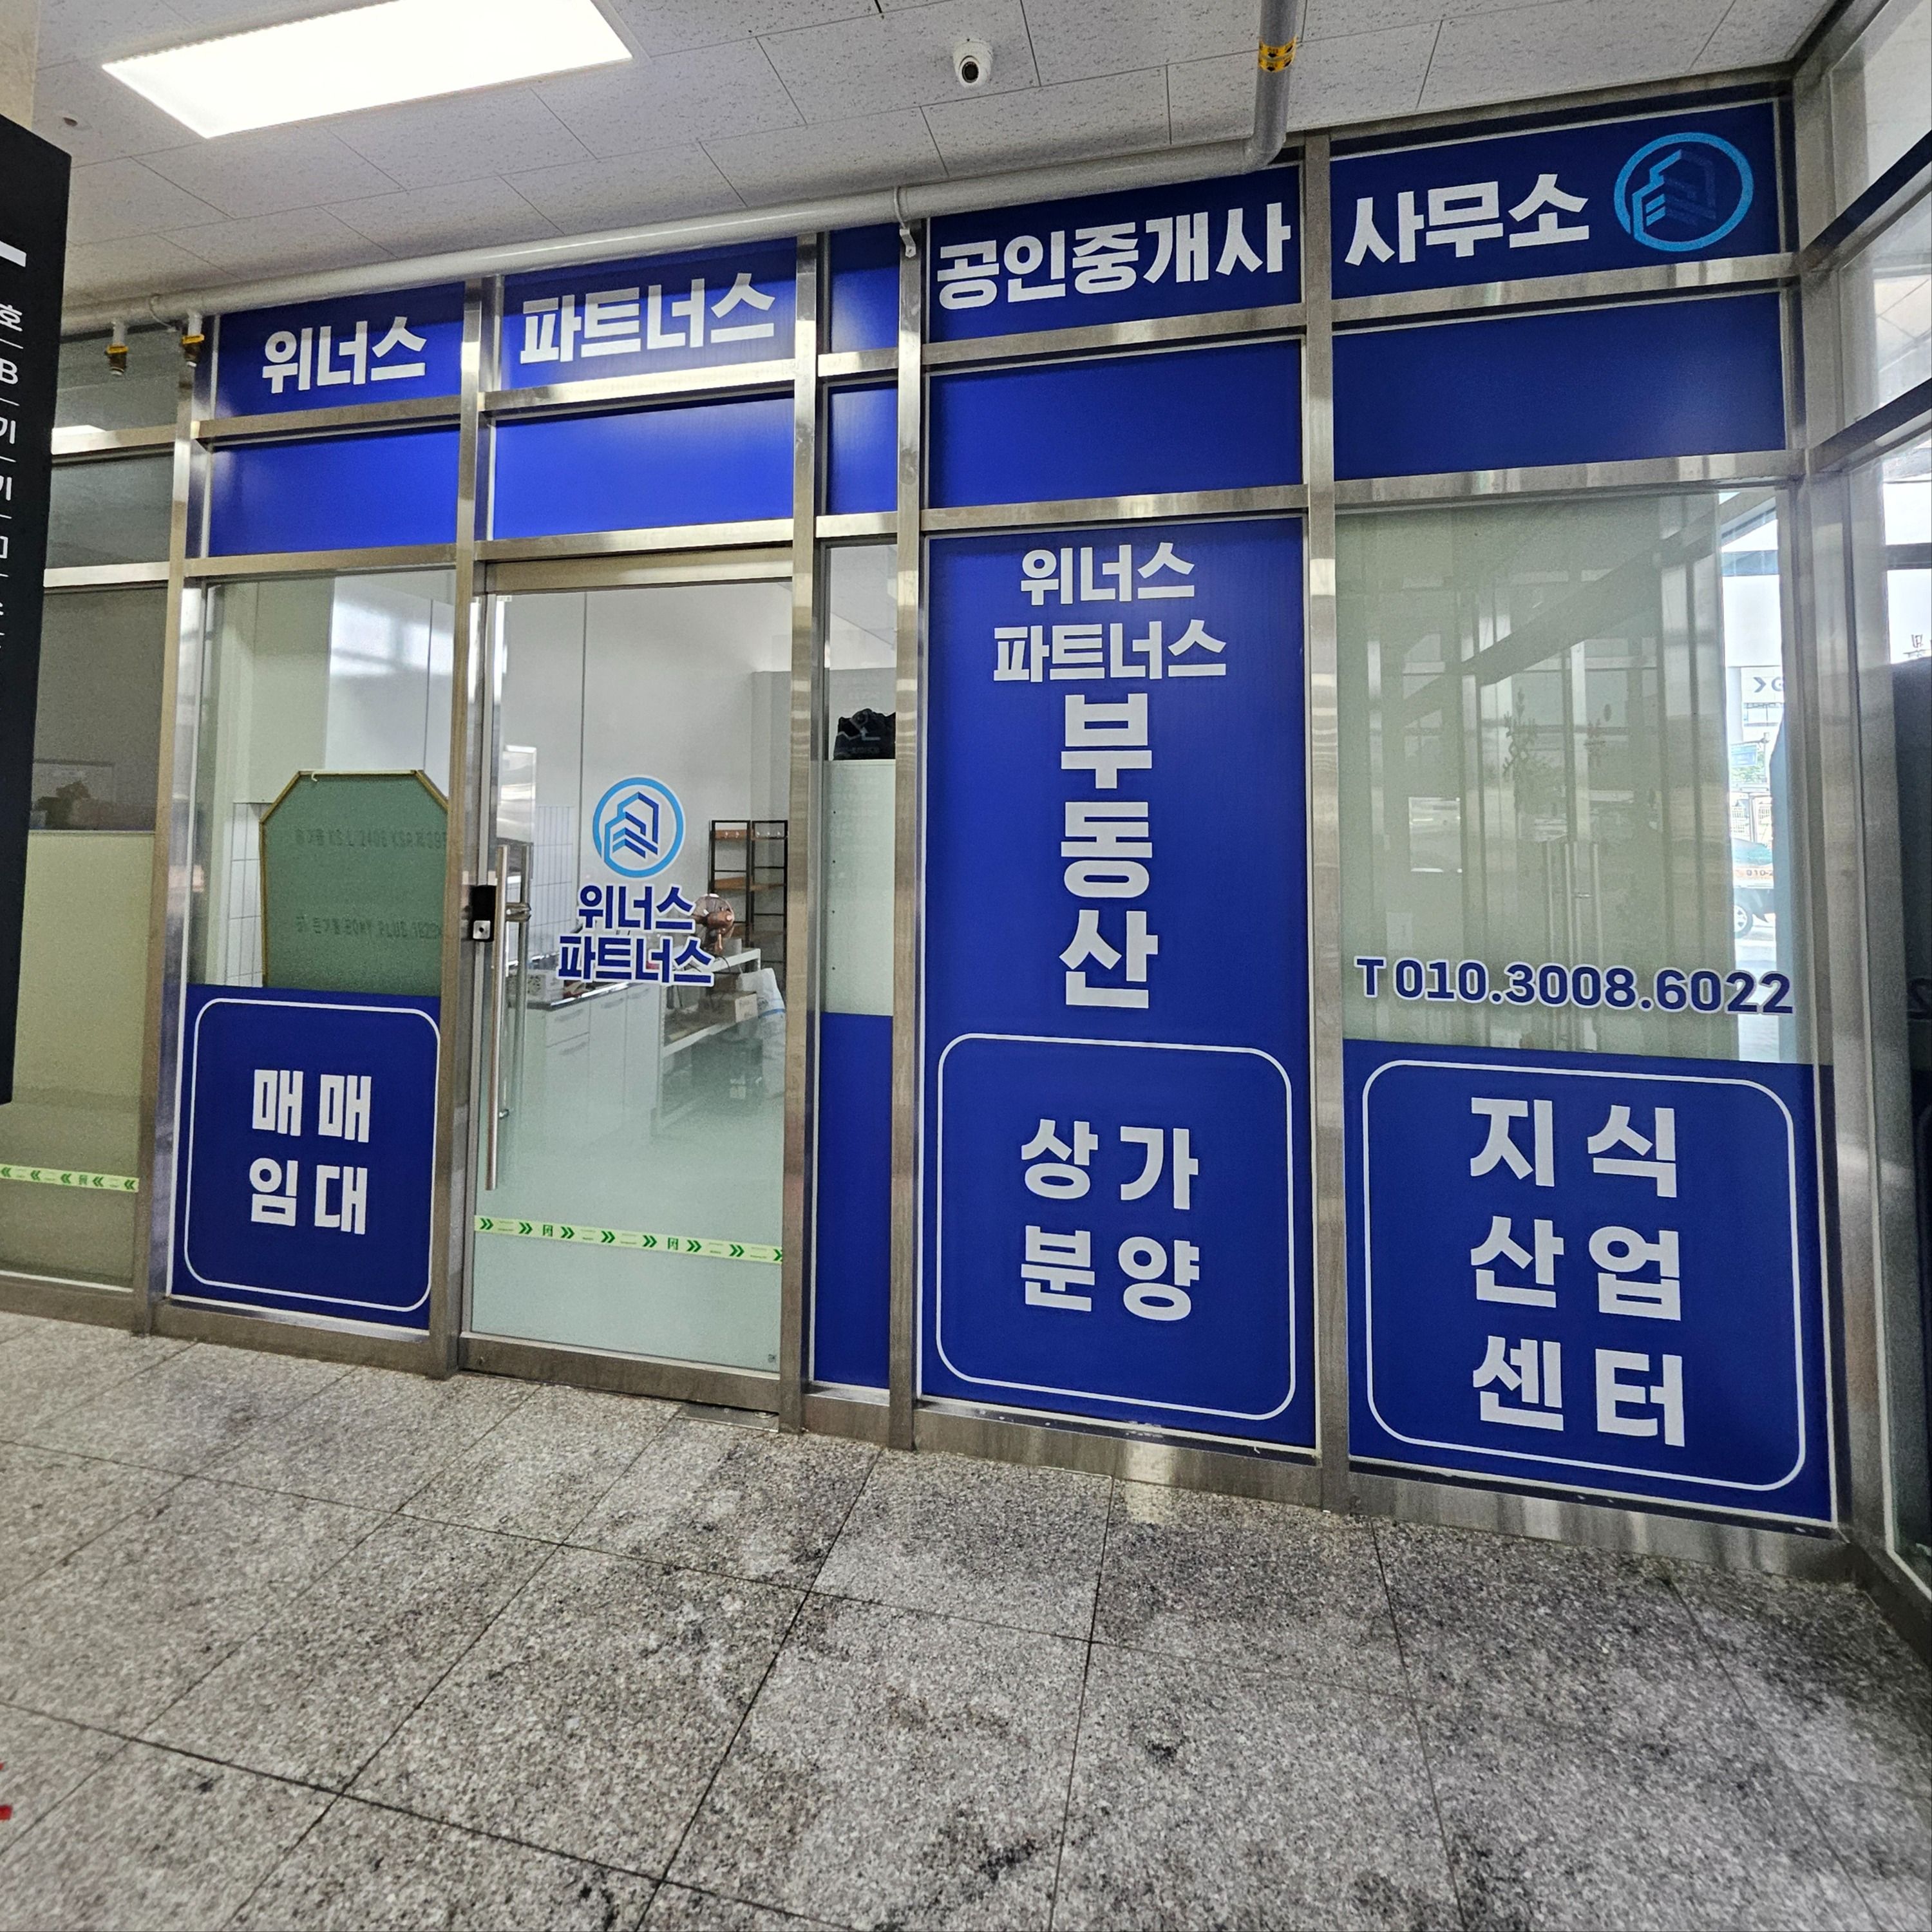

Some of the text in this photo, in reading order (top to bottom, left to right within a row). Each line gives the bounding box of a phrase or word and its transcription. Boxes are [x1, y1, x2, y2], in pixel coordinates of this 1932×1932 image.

[262, 174, 1589, 393] 위너스 파트너스 공인중개사 사무소
[1021, 542, 1195, 605] 위너스
[993, 619, 1227, 683] 파트너스
[1059, 693, 1159, 1009] 부동산
[578, 884, 696, 931] 위너스
[558, 935, 713, 985] 파트너스
[1356, 958, 1795, 1014] T 010.3008.6022
